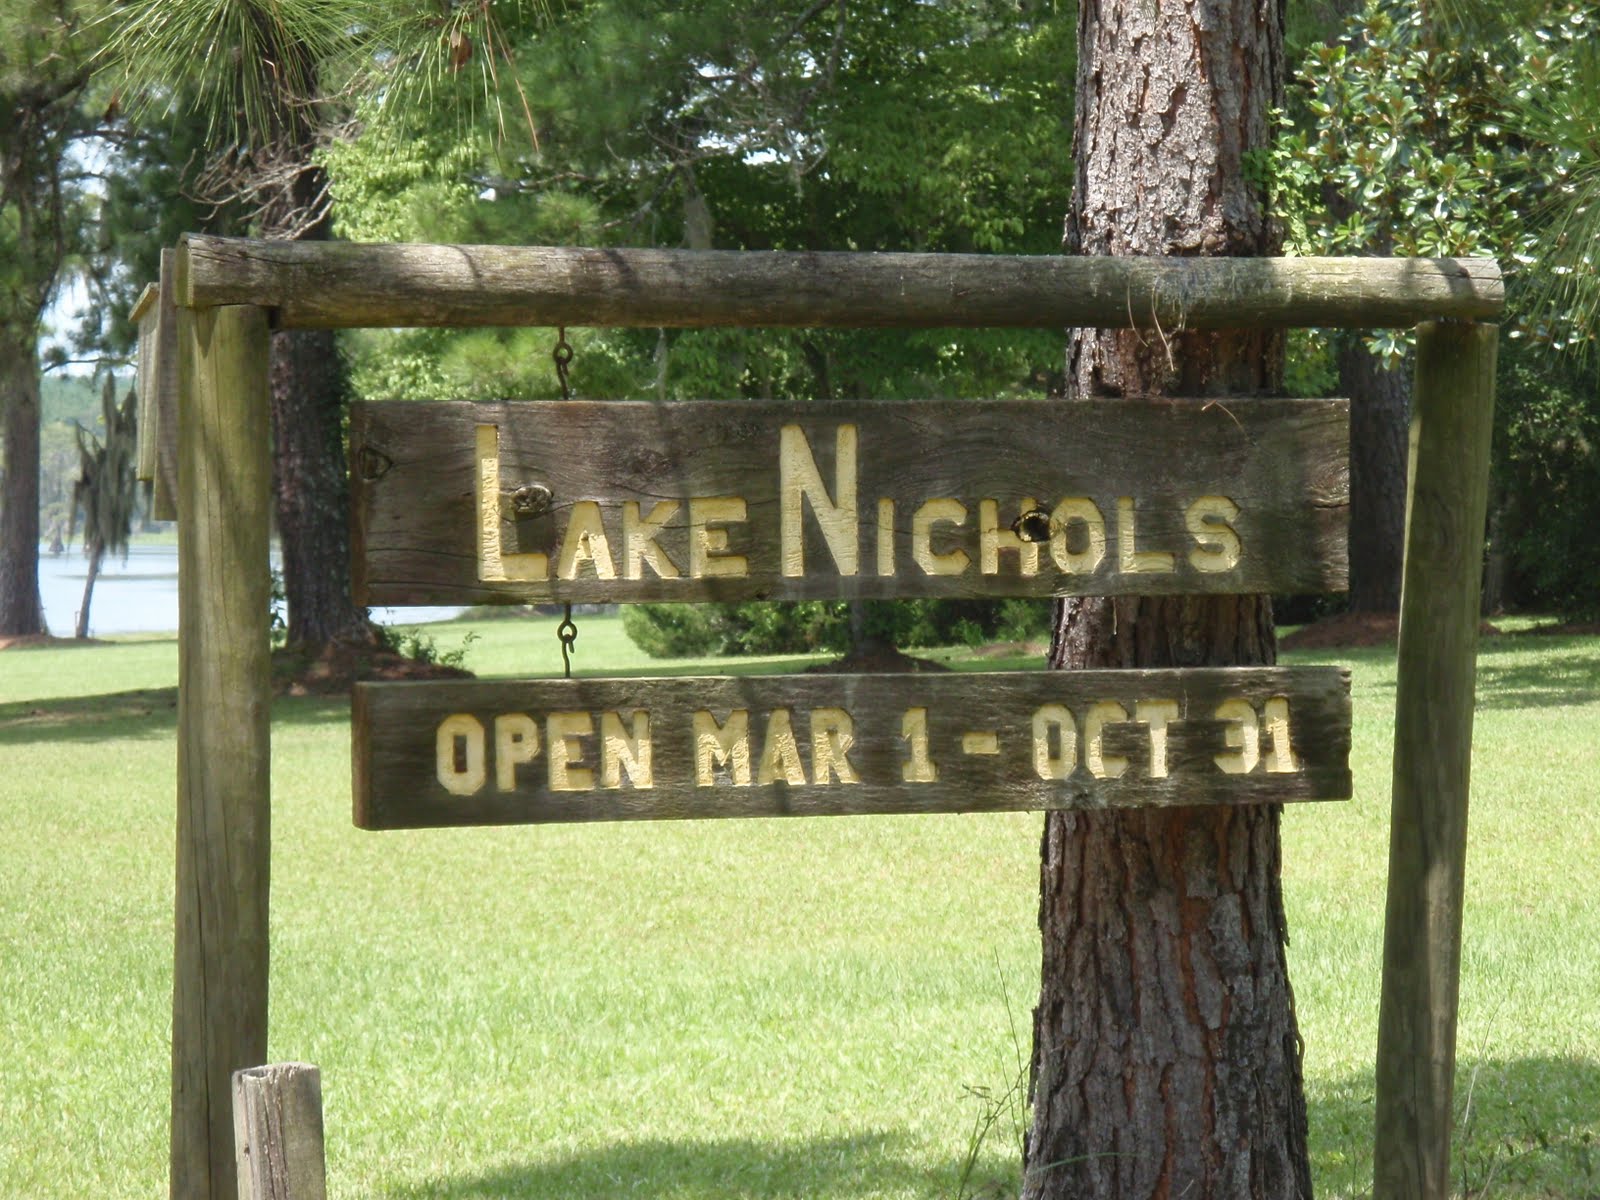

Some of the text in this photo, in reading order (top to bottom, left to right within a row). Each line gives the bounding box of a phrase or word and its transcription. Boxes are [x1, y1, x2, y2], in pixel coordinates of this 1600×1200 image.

[436, 696, 1300, 796] OPEN MAR 1 - OCT 31
